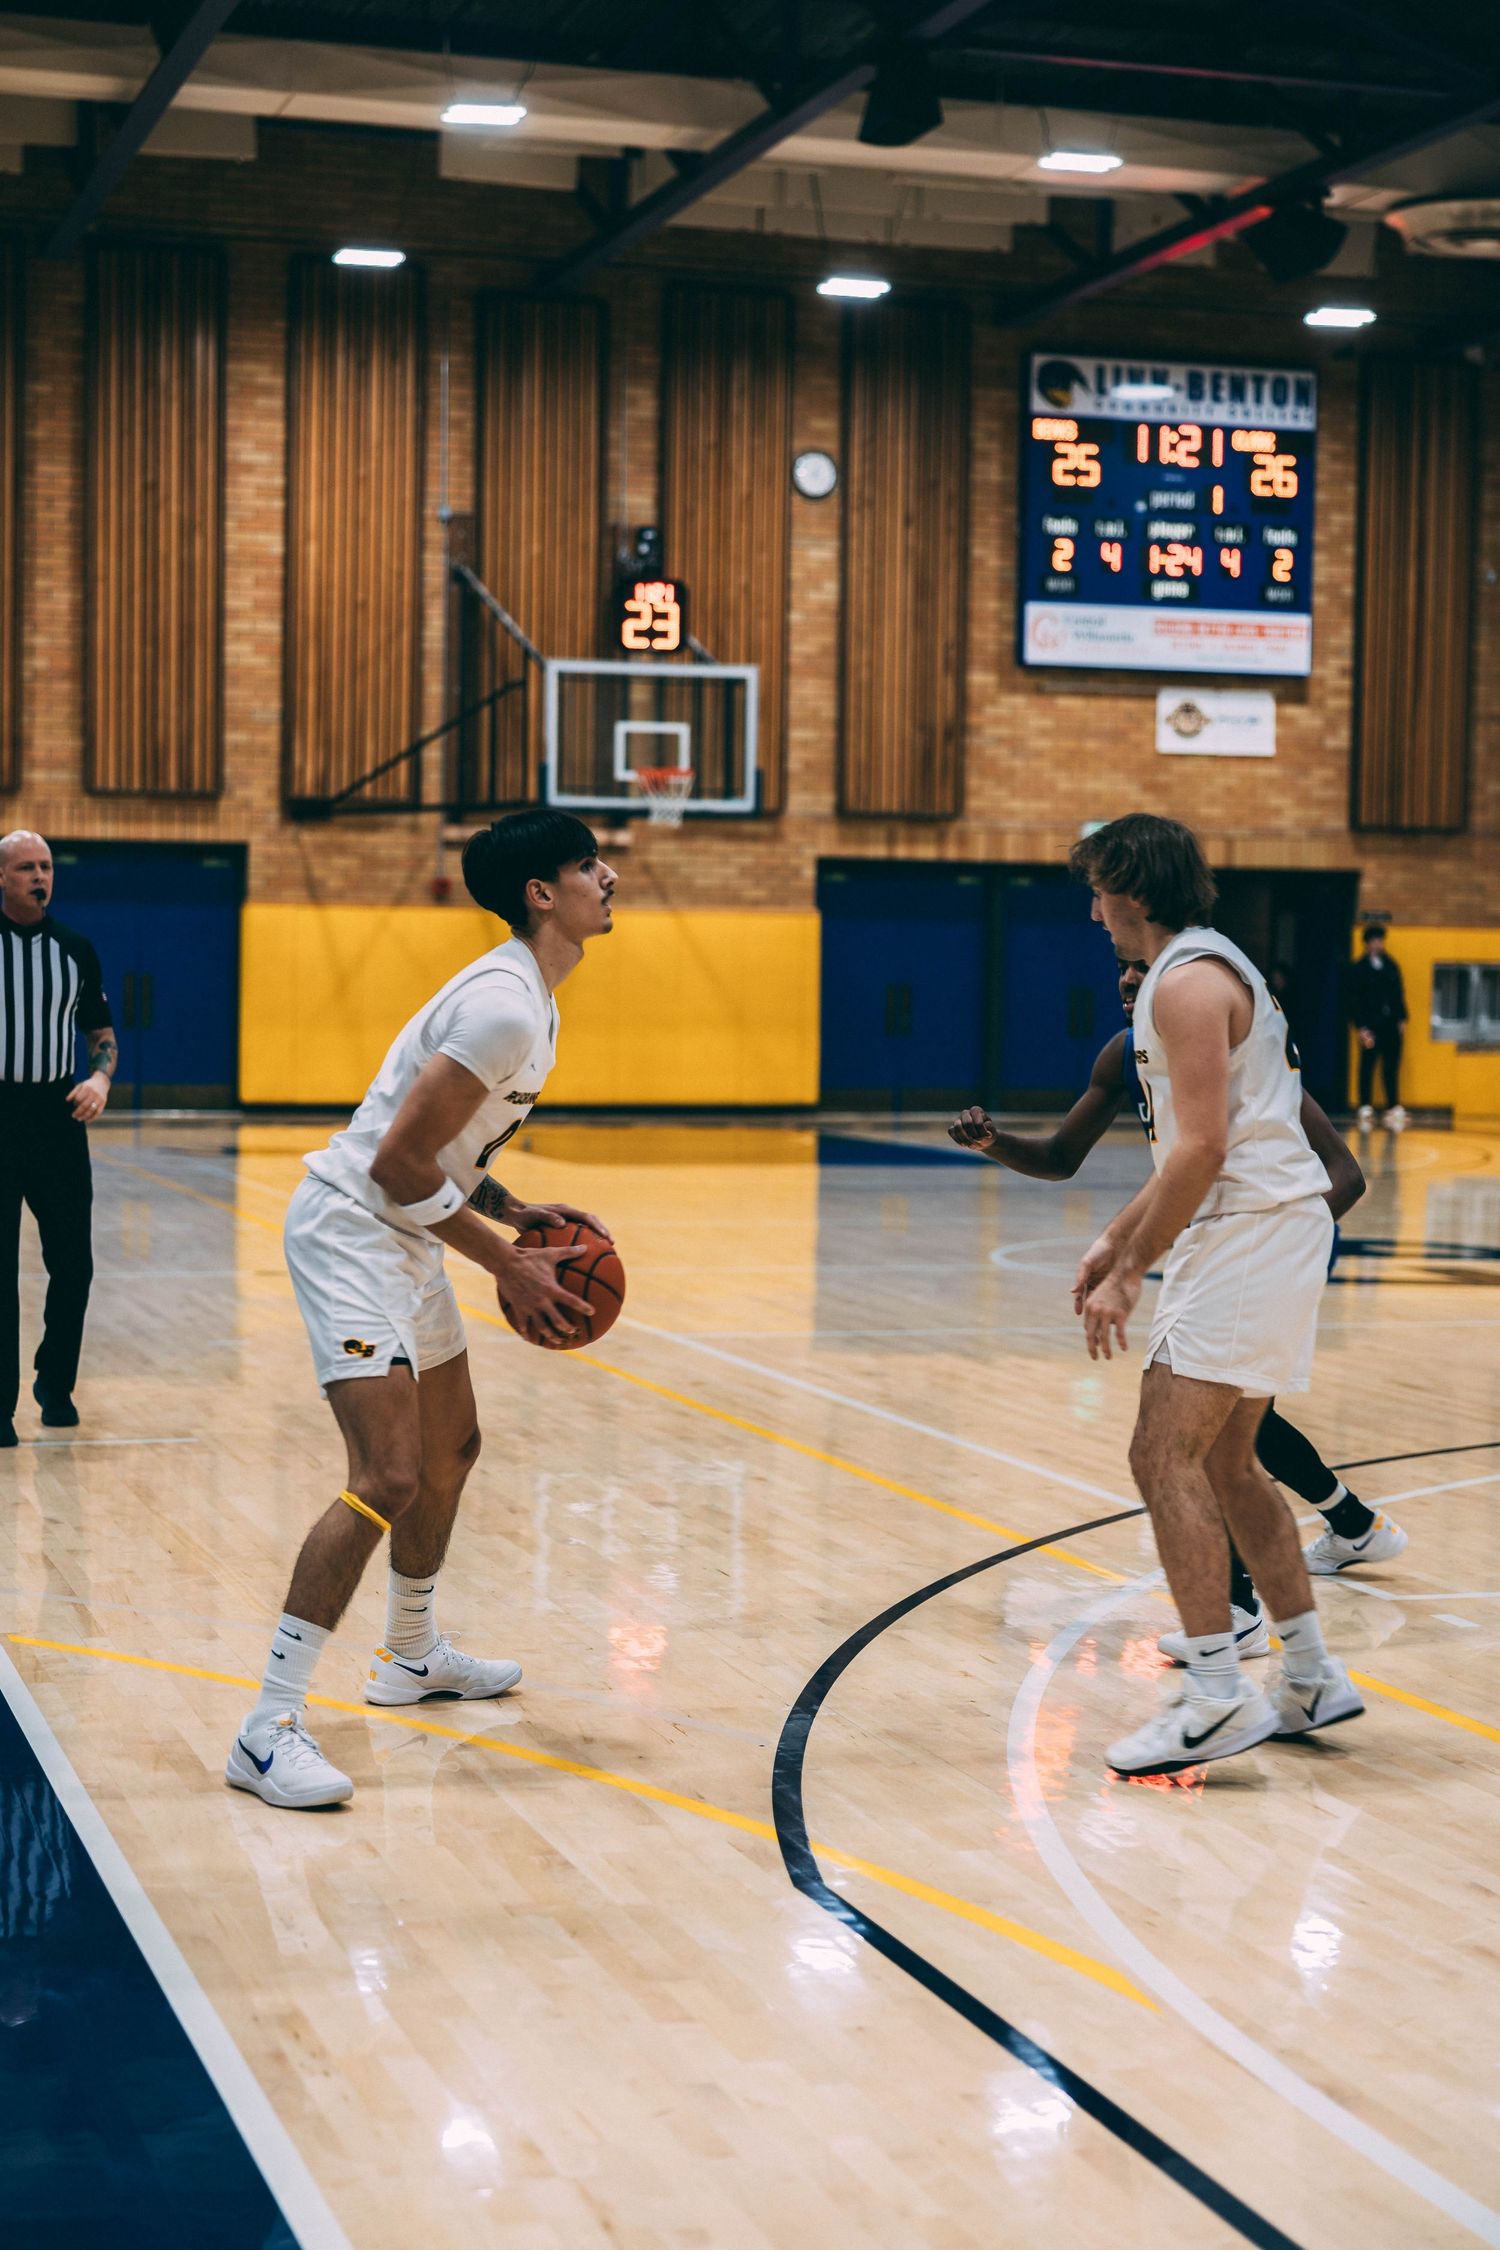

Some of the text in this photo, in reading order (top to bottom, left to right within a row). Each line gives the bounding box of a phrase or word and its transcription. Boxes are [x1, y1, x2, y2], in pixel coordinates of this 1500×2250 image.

[1137, 423, 1223, 467] 11:21
[1052, 442, 1101, 488] 25
[1250, 453, 1298, 498] 26
[1212, 484, 1224, 515] 1
[1051, 537, 1075, 572] 2
[1100, 541, 1122, 573] 4
[1220, 548, 1241, 578] 4
[1272, 548, 1294, 582] 2
[621, 599, 680, 650] 23
